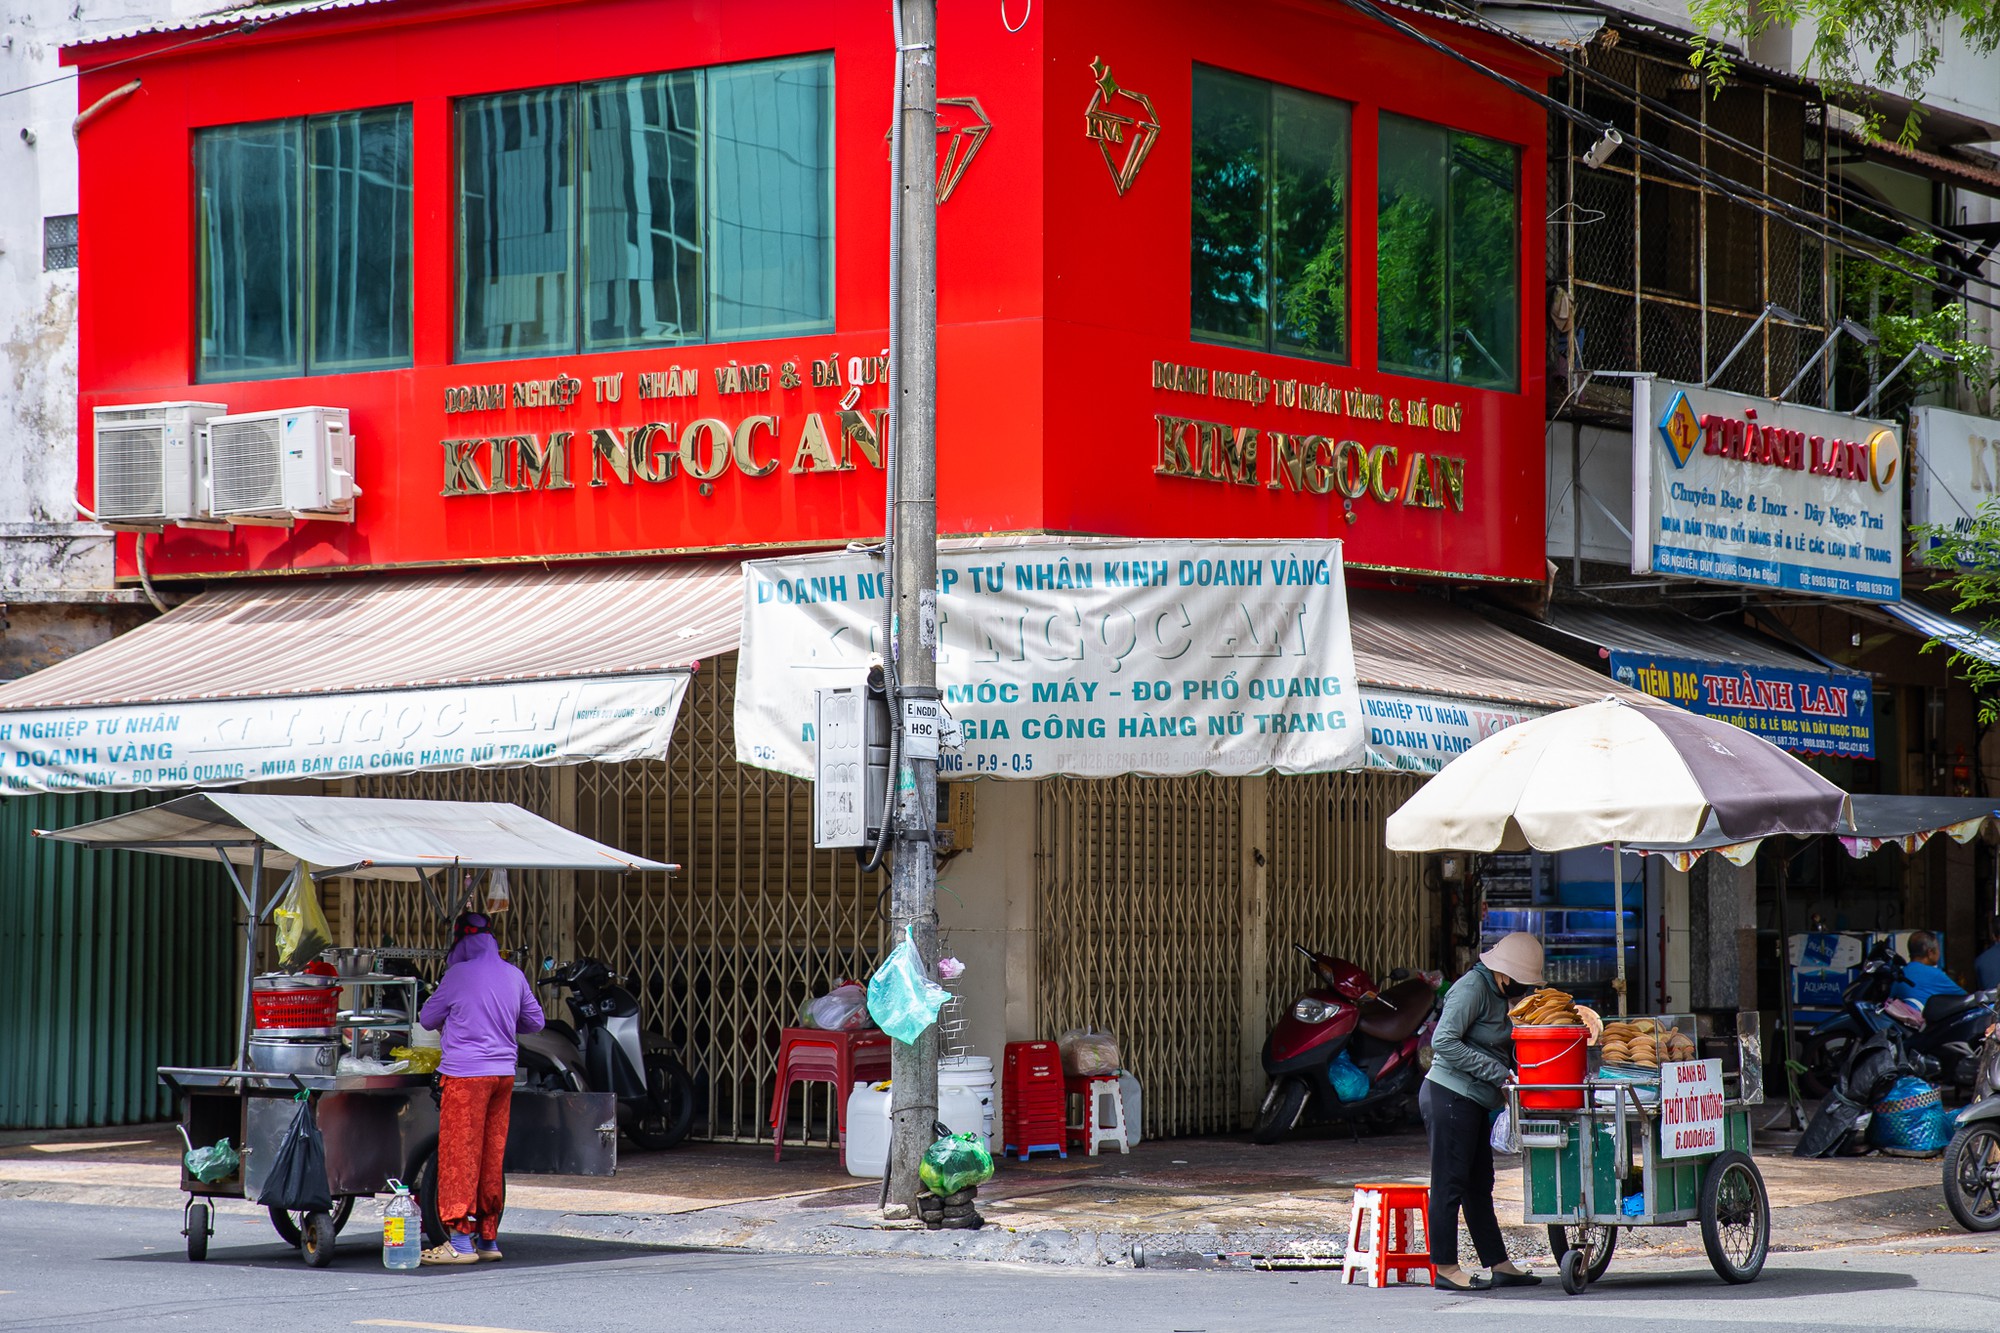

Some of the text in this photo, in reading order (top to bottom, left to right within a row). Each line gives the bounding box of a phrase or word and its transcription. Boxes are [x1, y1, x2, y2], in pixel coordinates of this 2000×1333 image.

[445, 349, 890, 414] DOANH NGHIỆP TƯ NHÂN VÀNG & ĐÁ QUÝ
[1152, 359, 1464, 432] DOANH NGHIỆP TƯ NHÂN VÀNG & ĐÁ QUÝ
[439, 408, 890, 498] KIM NGỌC AN
[1700, 408, 1869, 483] THÀNH LAN
[1152, 414, 1467, 525] KIM NGỌC AN
[1670, 481, 1717, 508] Chuyên
[1720, 489, 1743, 517] Bạc
[1748, 494, 1757, 513] &
[1762, 496, 1788, 517] Inox
[1804, 502, 1826, 527] Dây
[1829, 506, 1857, 533] Ngọc
[1860, 511, 1884, 530] Trai
[1661, 516, 1681, 533] MUA
[1684, 516, 1702, 536] BÁN
[1704, 523, 1728, 541] TRAO
[1748, 526, 1772, 547] HÀNG
[1785, 535, 1792, 550] &
[1795, 532, 1806, 552] LẺ
[1809, 536, 1825, 554] CÁC
[1827, 541, 1846, 560] LOẠI
[1865, 547, 1891, 564] TRANG
[757, 553, 1331, 606] DOANH TƯ NHÂN KINH DOANH VÀNG
[1661, 553, 1670, 566] 68
[1671, 552, 1698, 571] NGUYỄN
[1699, 559, 1713, 573] DUY
[1752, 567, 1761, 579] An
[1839, 578, 1850, 590] 721
[1882, 585, 1893, 596] 721
[947, 678, 1019, 703] MÓC
[1031, 676, 1099, 703] MÁY
[1132, 680, 1172, 702] ĐO
[1183, 670, 1239, 700] PHỔ
[1248, 676, 1342, 701] QUANG
[1672, 670, 1699, 706] BẠC
[1702, 669, 1796, 713] THÀNH
[1798, 684, 1848, 717] LAN
[654, 706, 666, 717] Q.5
[907, 703, 938, 718] E NGDD
[962, 719, 1010, 740] GIA
[1021, 713, 1106, 740] CÔNG
[1118, 712, 1198, 739] HÀNG
[1208, 711, 1245, 736] NỮ
[1254, 710, 1347, 735] TRANG
[1367, 698, 1413, 723] NGHIỆP
[1416, 704, 1434, 723] TƯ
[1435, 705, 1469, 727] NHÂN
[1731, 711, 1870, 739] ĐỔI SỈ & LẺ BẠC VÀ DÂY NGỌC TRAI
[19, 716, 89, 741] NGHIỆP
[96, 716, 122, 736] TƯ
[125, 712, 180, 734] NHÂN
[911, 723, 933, 736] H9C
[1371, 727, 1473, 754] DOANH VÀNG
[7, 775, 29, 791] MẠ
[46, 769, 80, 788] MÓC
[85, 769, 116, 787] MÁY
[132, 768, 152, 784] ĐO
[158, 760, 188, 782] PHỔ
[194, 763, 244, 782] QUANG
[262, 760, 296, 775] MUA
[301, 753, 332, 773] BÁN
[338, 753, 364, 771] GIA
[370, 747, 414, 768] CÔNG
[420, 744, 464, 765] HÀNG
[471, 743, 496, 762] NỮ
[499, 742, 557, 760] TRANG
[15, 747, 97, 768] DOANH
[108, 739, 173, 764] VÀNG
[977, 754, 998, 771] P.9
[1012, 753, 1033, 773] Q.5
[1396, 752, 1421, 771] MÓC
[1422, 754, 1442, 772] MÁY
[1803, 981, 1841, 994] AQUAFINA
[1677, 1060, 1707, 1084] BÁNH BÒ
[1664, 1088, 1684, 1125] THỐT
[1685, 1086, 1700, 1123] NỐT
[1675, 1127, 1716, 1150] 6.000đ/cái
